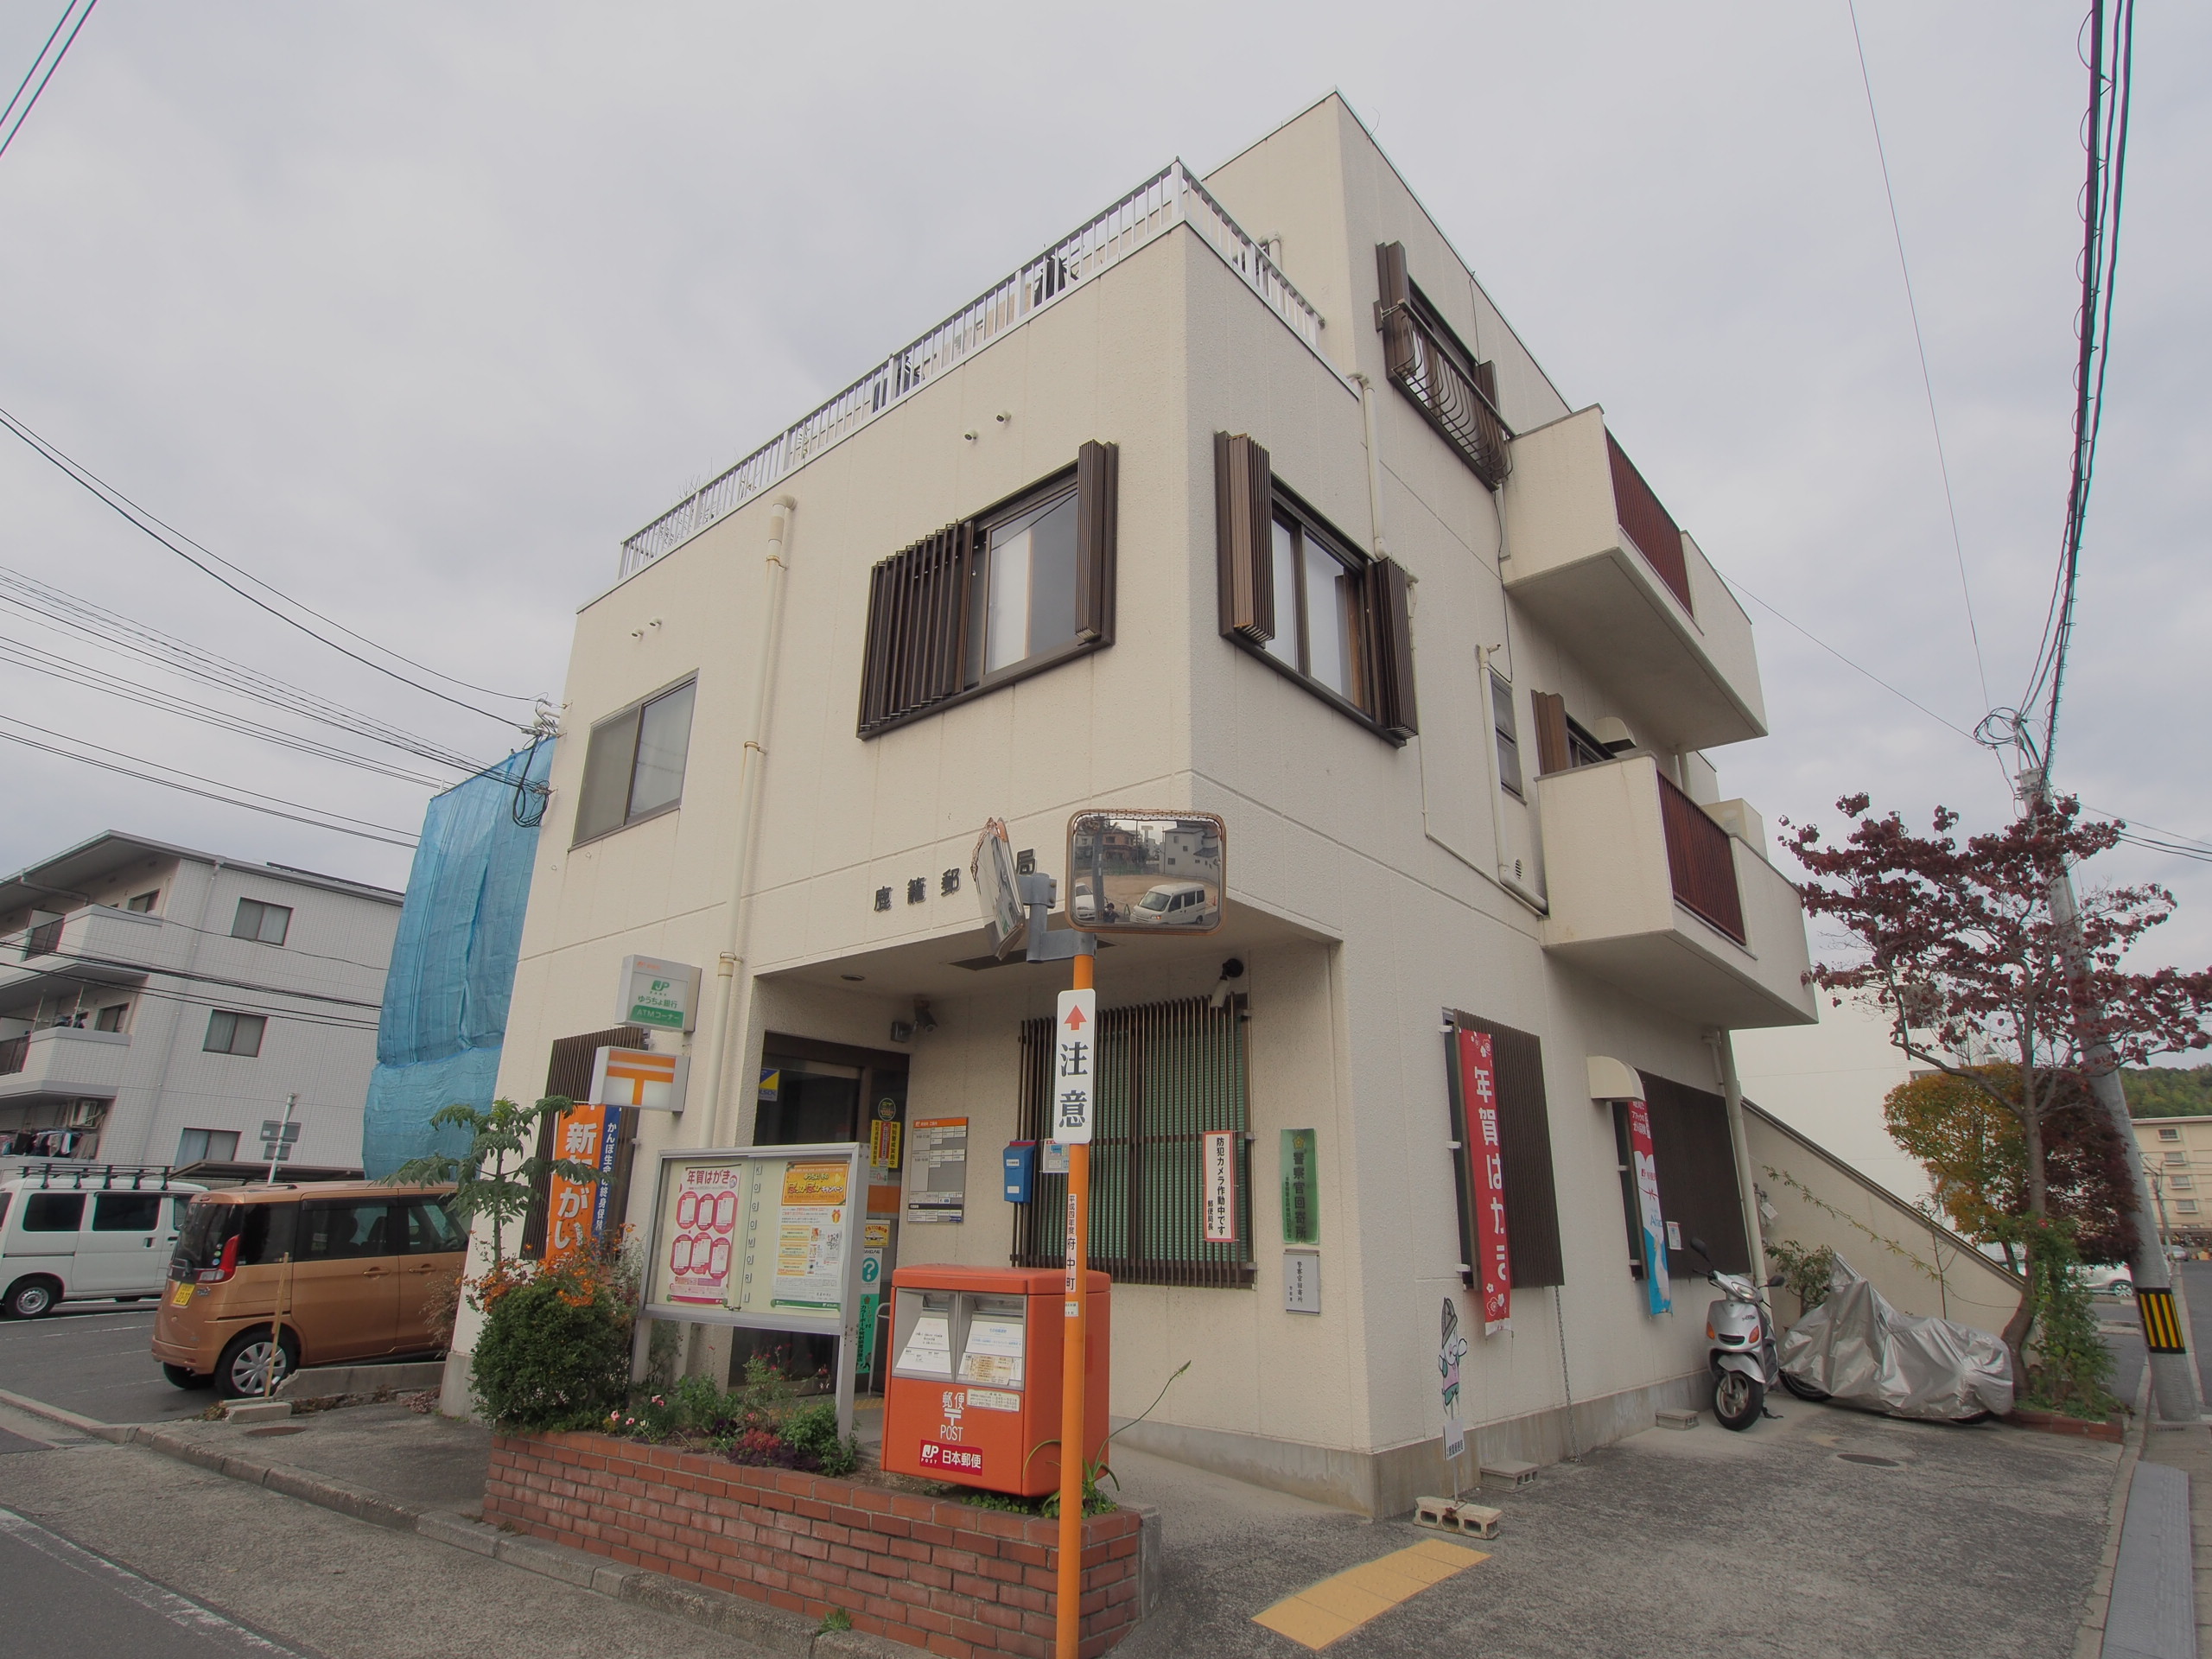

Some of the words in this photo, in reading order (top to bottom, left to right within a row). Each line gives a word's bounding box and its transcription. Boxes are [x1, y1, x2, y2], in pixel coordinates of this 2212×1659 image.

[874, 849, 1035, 912] 鹿籠郵局
[652, 980, 670, 991] JP
[638, 995, 677, 1008] ゆうちょ銀行
[637, 1008, 679, 1020] ATMコーナー
[1058, 1041, 1089, 1128] 注意
[687, 1169, 730, 1185] 年賀はがき
[1217, 1137, 1225, 1236] 防犯カメラ作動中です
[552, 1122, 597, 1268] 新がい
[1066, 1237, 1077, 1291] 府中町
[942, 1391, 965, 1410] 郵便
[939, 1424, 963, 1442] POST
[921, 1444, 939, 1459] JP
[942, 1450, 982, 1469] 日本郵便
